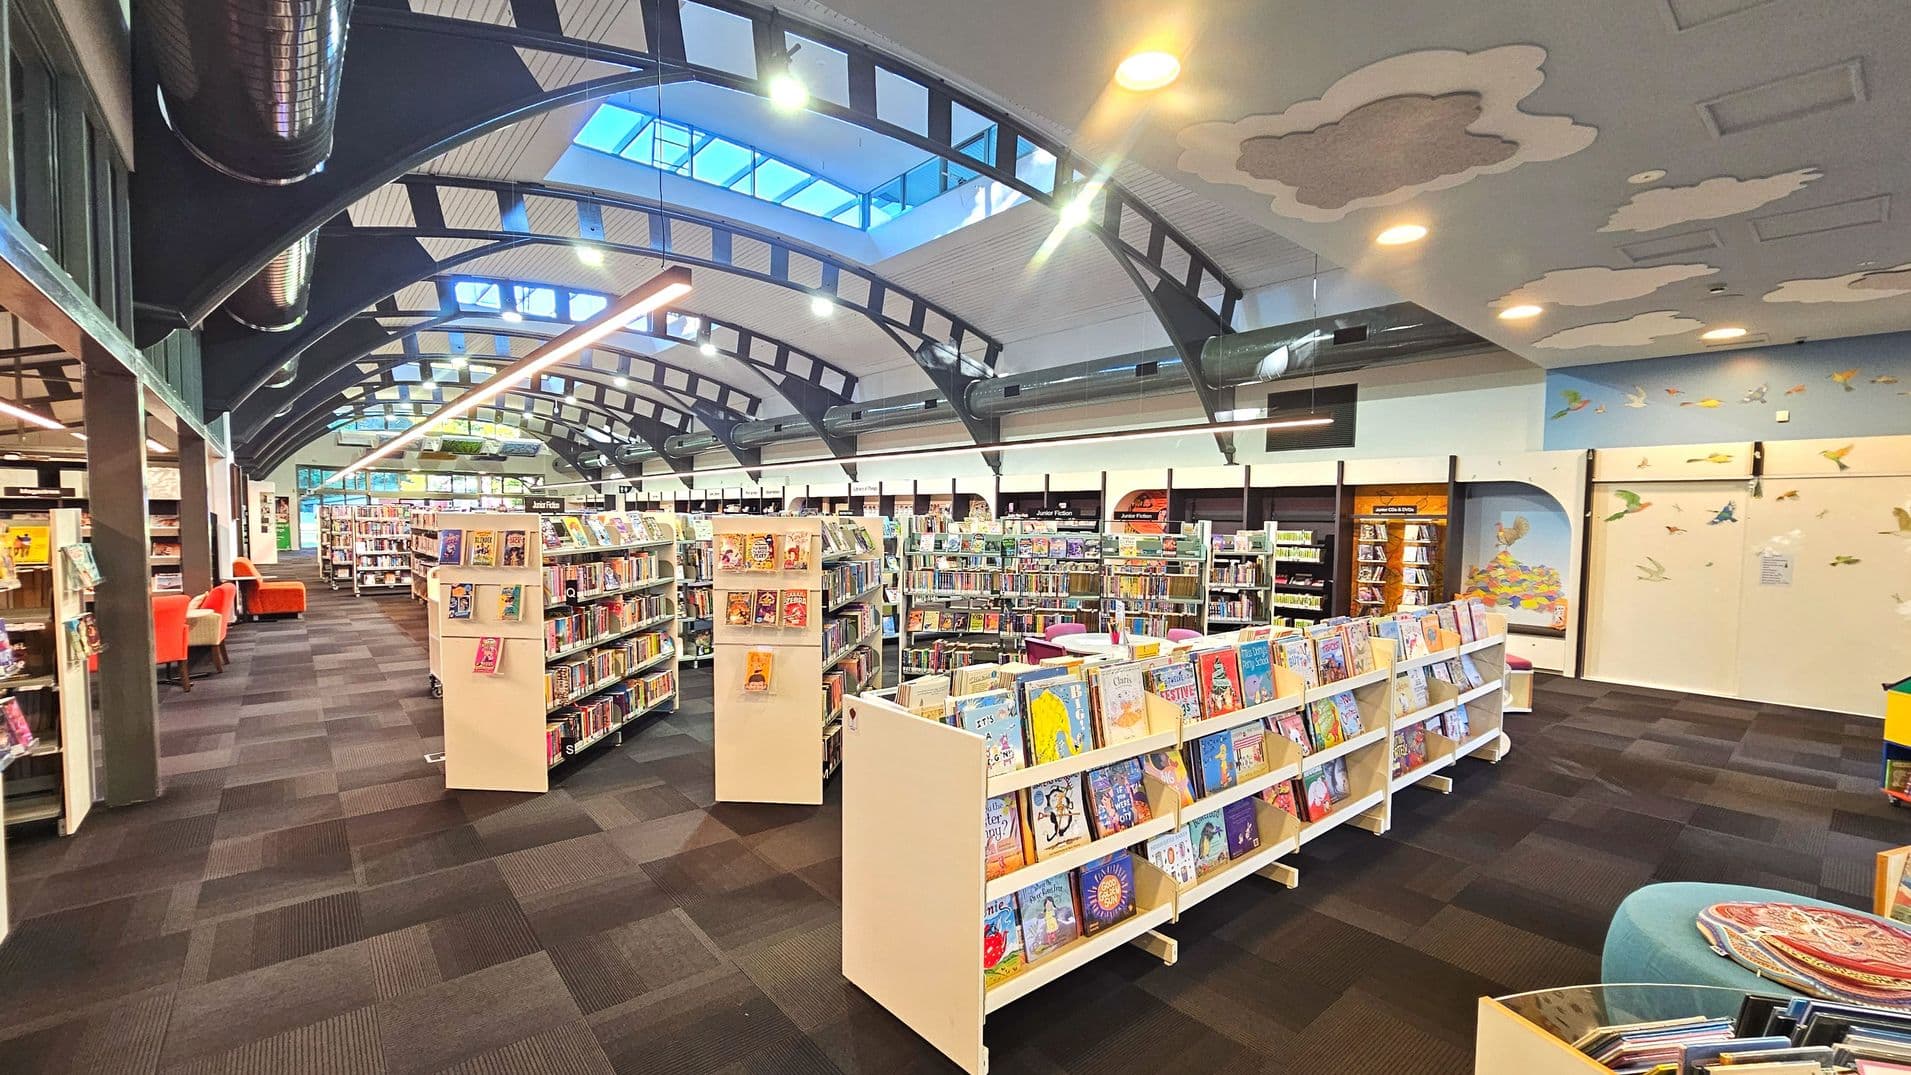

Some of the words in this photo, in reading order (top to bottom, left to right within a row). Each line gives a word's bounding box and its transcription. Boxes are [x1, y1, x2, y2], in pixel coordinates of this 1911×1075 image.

[532, 500, 546, 509] Junior
[546, 501, 560, 509] Fiction
[566, 588, 576, 598] Q
[976, 714, 995, 730] IT'S
[985, 732, 993, 741] A
[565, 745, 575, 755] S
[985, 812, 1003, 827] ter
[1119, 811, 1132, 824] CITY
[1103, 895, 1118, 907] SUN
